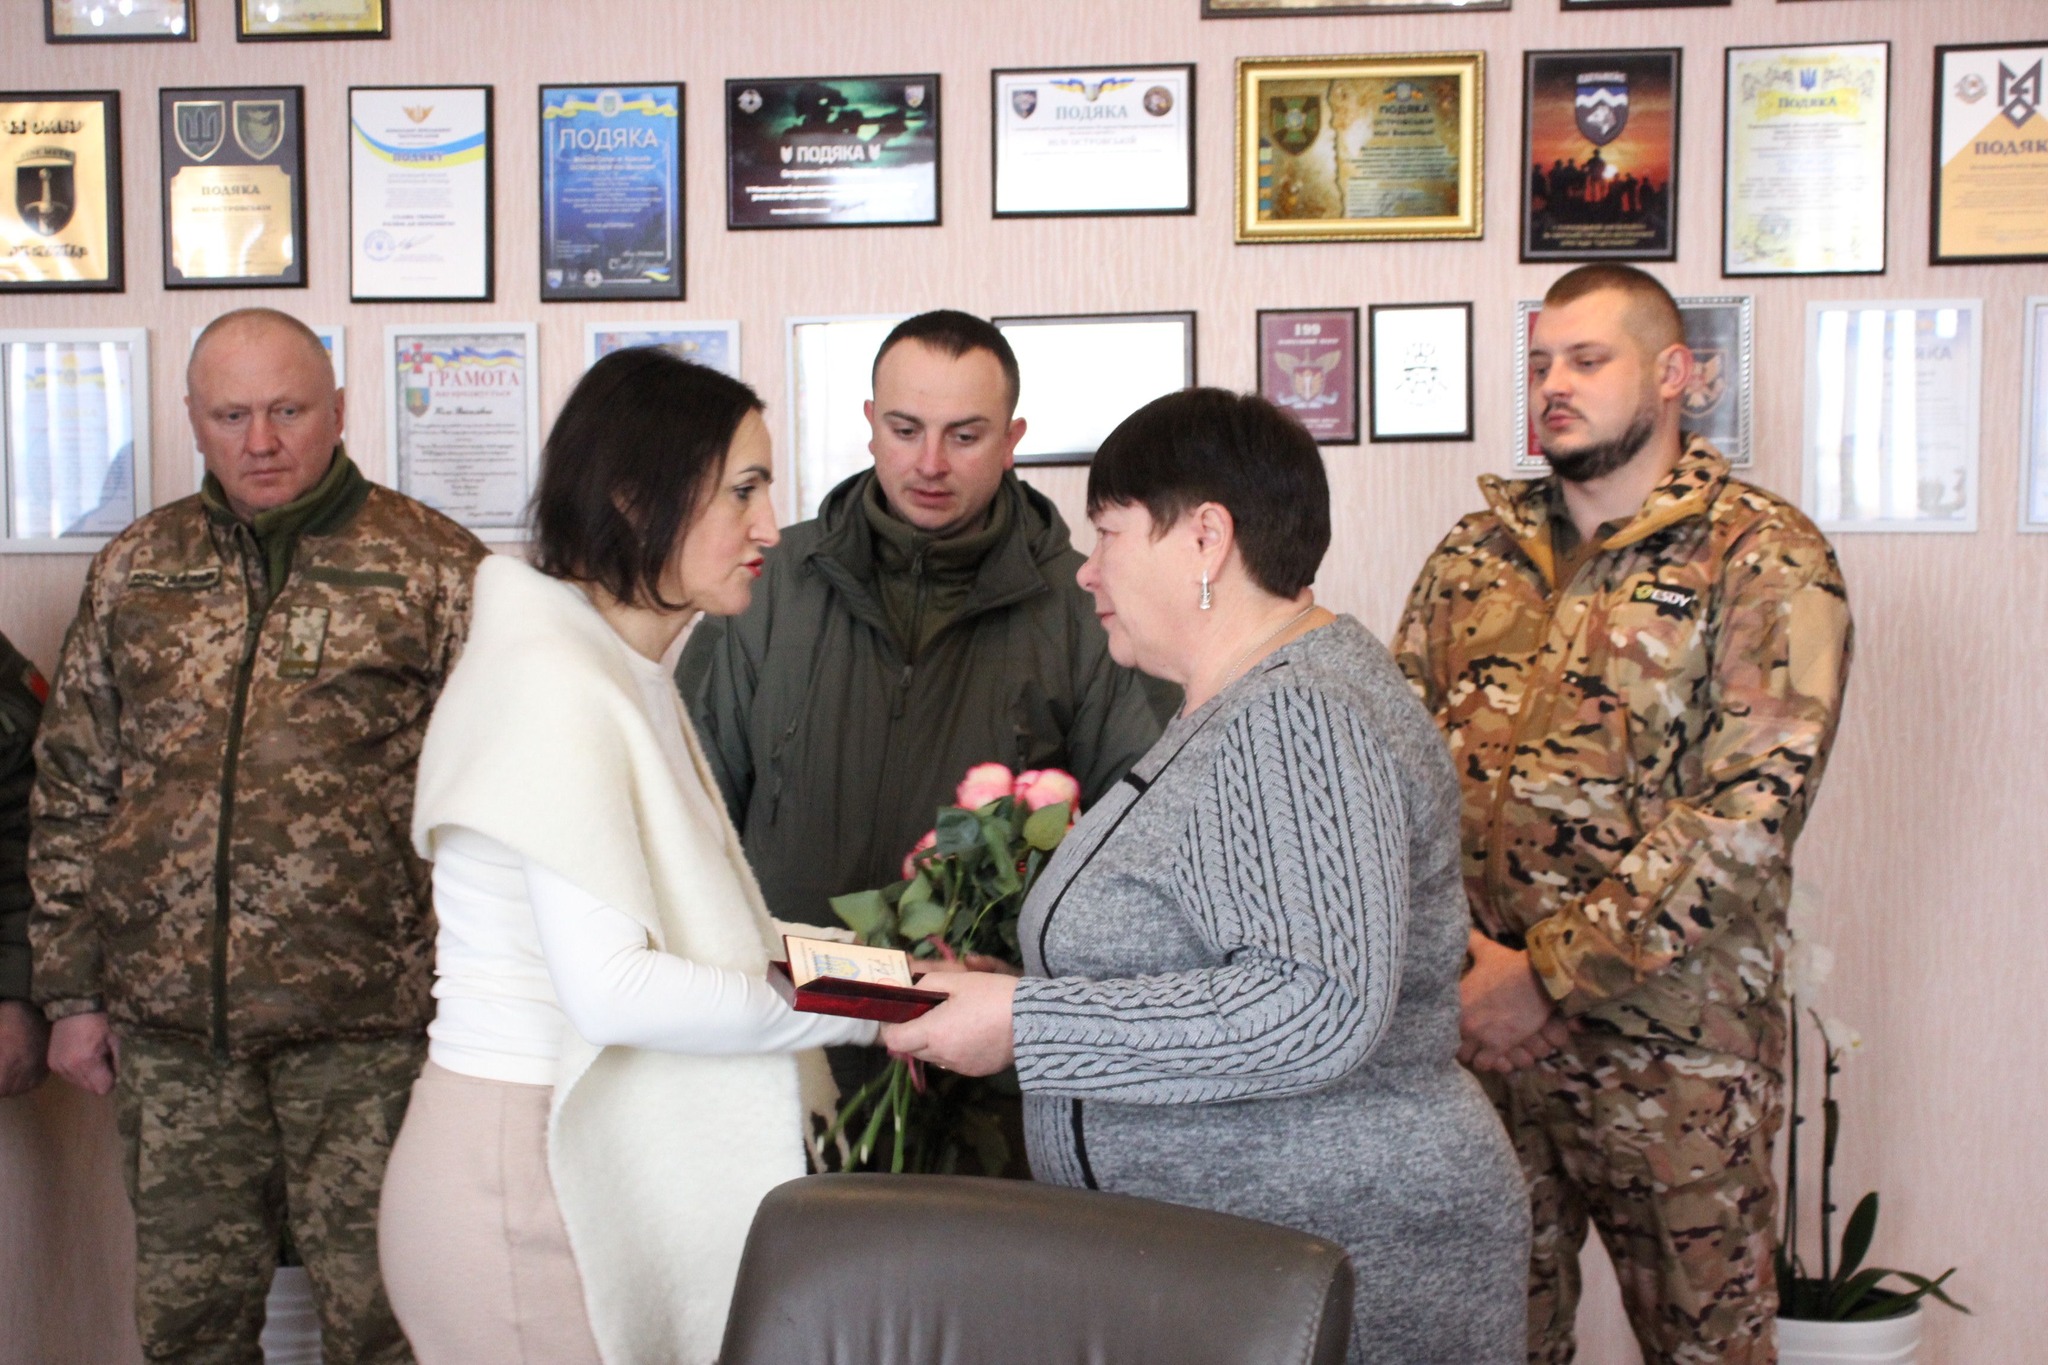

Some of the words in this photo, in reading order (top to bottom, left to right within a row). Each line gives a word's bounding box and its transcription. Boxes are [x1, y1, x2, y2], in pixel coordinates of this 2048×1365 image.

[1055, 105, 1129, 121] ПОДЯКА
[560, 127, 659, 152] ПОДЯКА
[796, 144, 866, 164] ПОДЯКА
[201, 184, 261, 196] ПОДЯКА
[1294, 323, 1322, 336] 199
[427, 370, 520, 388] ГРАМОТА
